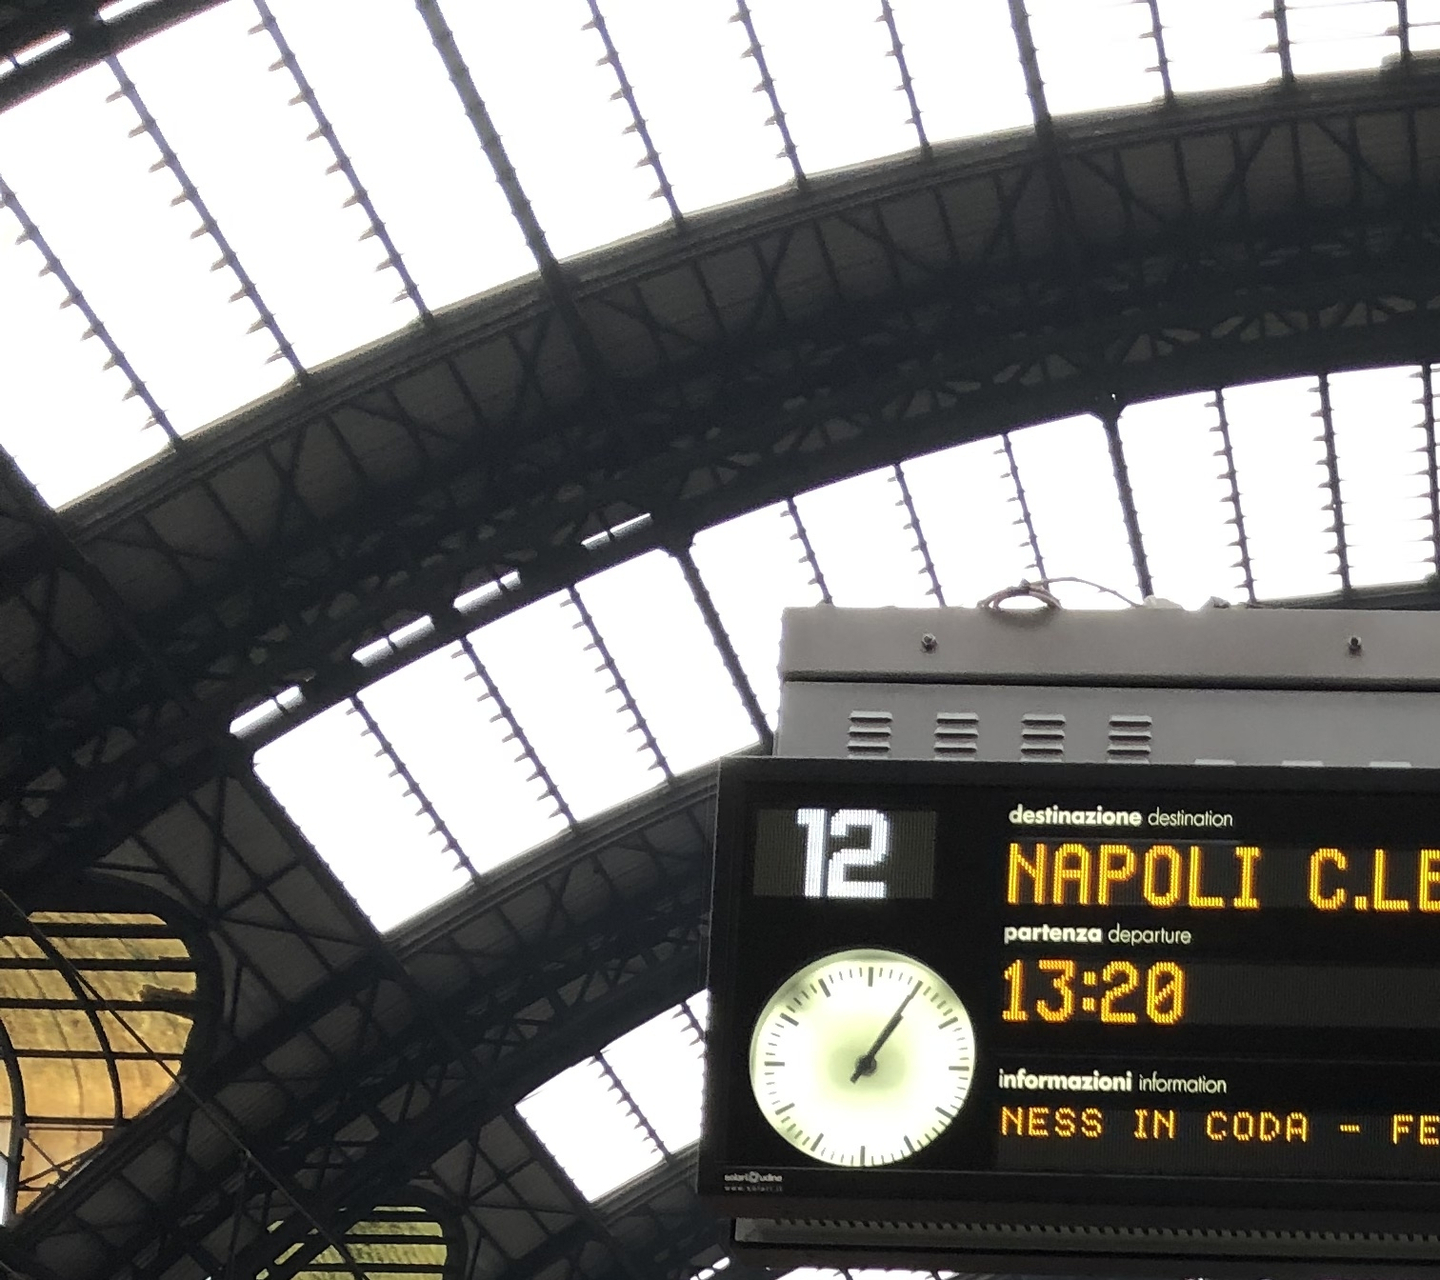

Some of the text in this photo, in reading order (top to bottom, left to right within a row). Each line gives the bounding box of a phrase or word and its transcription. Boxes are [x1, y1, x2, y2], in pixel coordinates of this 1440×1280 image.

[1008, 804, 1234, 828] destinazione destination
[796, 808, 890, 899] 12
[1006, 842, 1262, 911] NAPOLI
[1003, 924, 1192, 947] partenza departure
[1001, 959, 1186, 1026] 13:20
[999, 1068, 1227, 1094] informazioni information
[1001, 1106, 1103, 1138] NESS
[1134, 1108, 1177, 1140] IN
[1206, 1110, 1309, 1143] CODA
